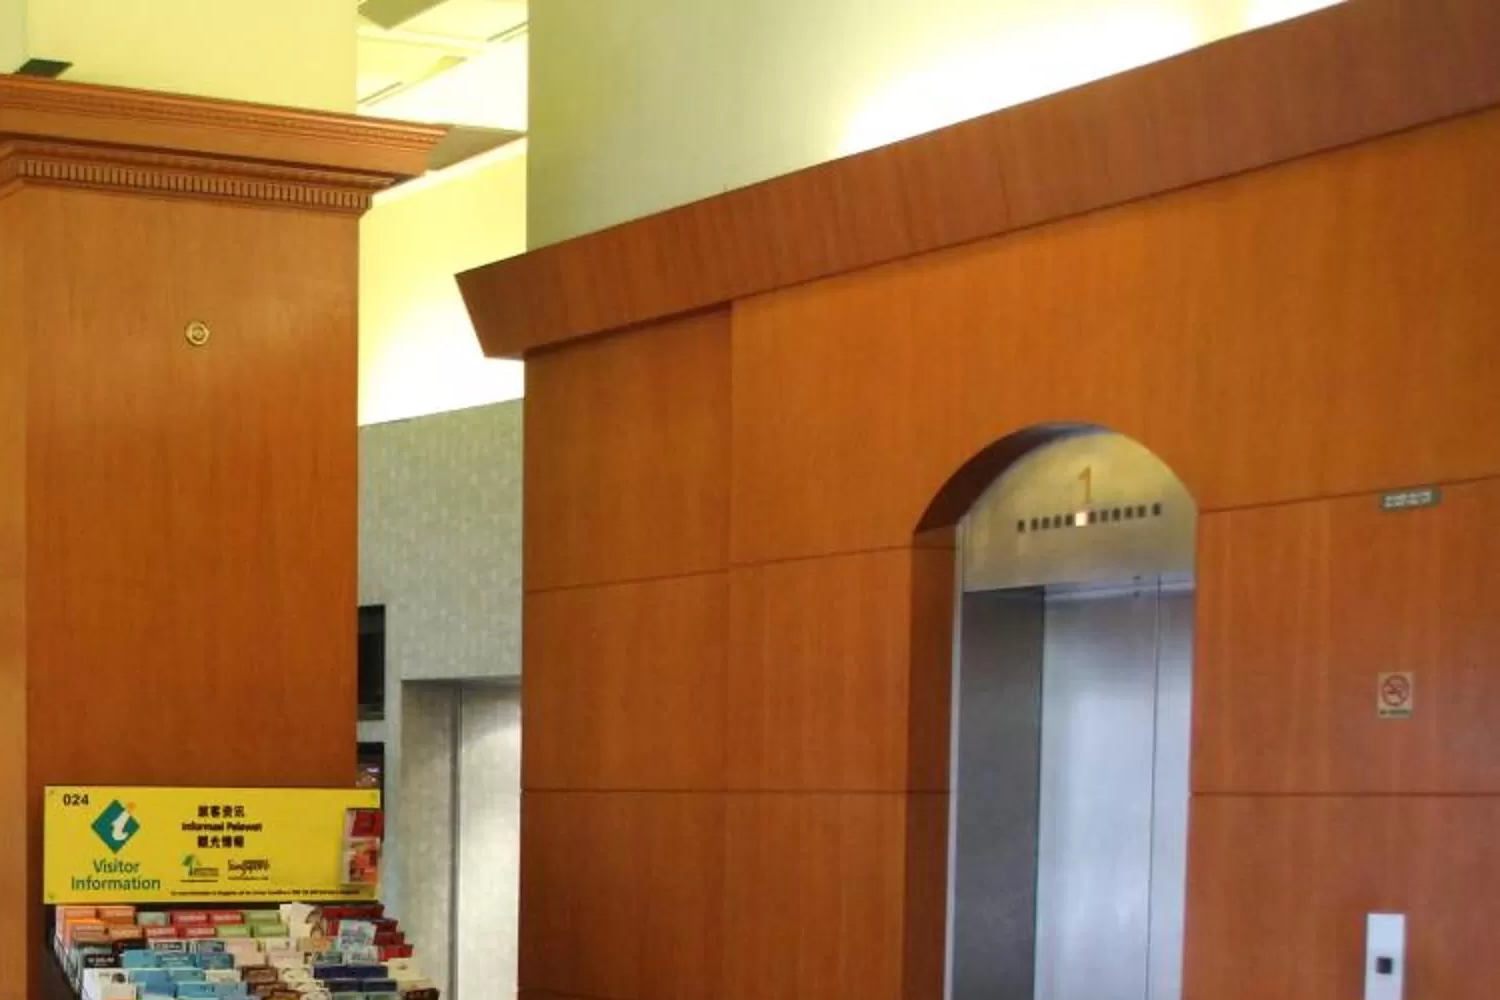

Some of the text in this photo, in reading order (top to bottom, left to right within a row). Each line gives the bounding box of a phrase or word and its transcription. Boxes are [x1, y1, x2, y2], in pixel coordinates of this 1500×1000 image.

[63, 793, 89, 806] 024
[92, 858, 140, 873] Visitor
[70, 874, 162, 891] Information
